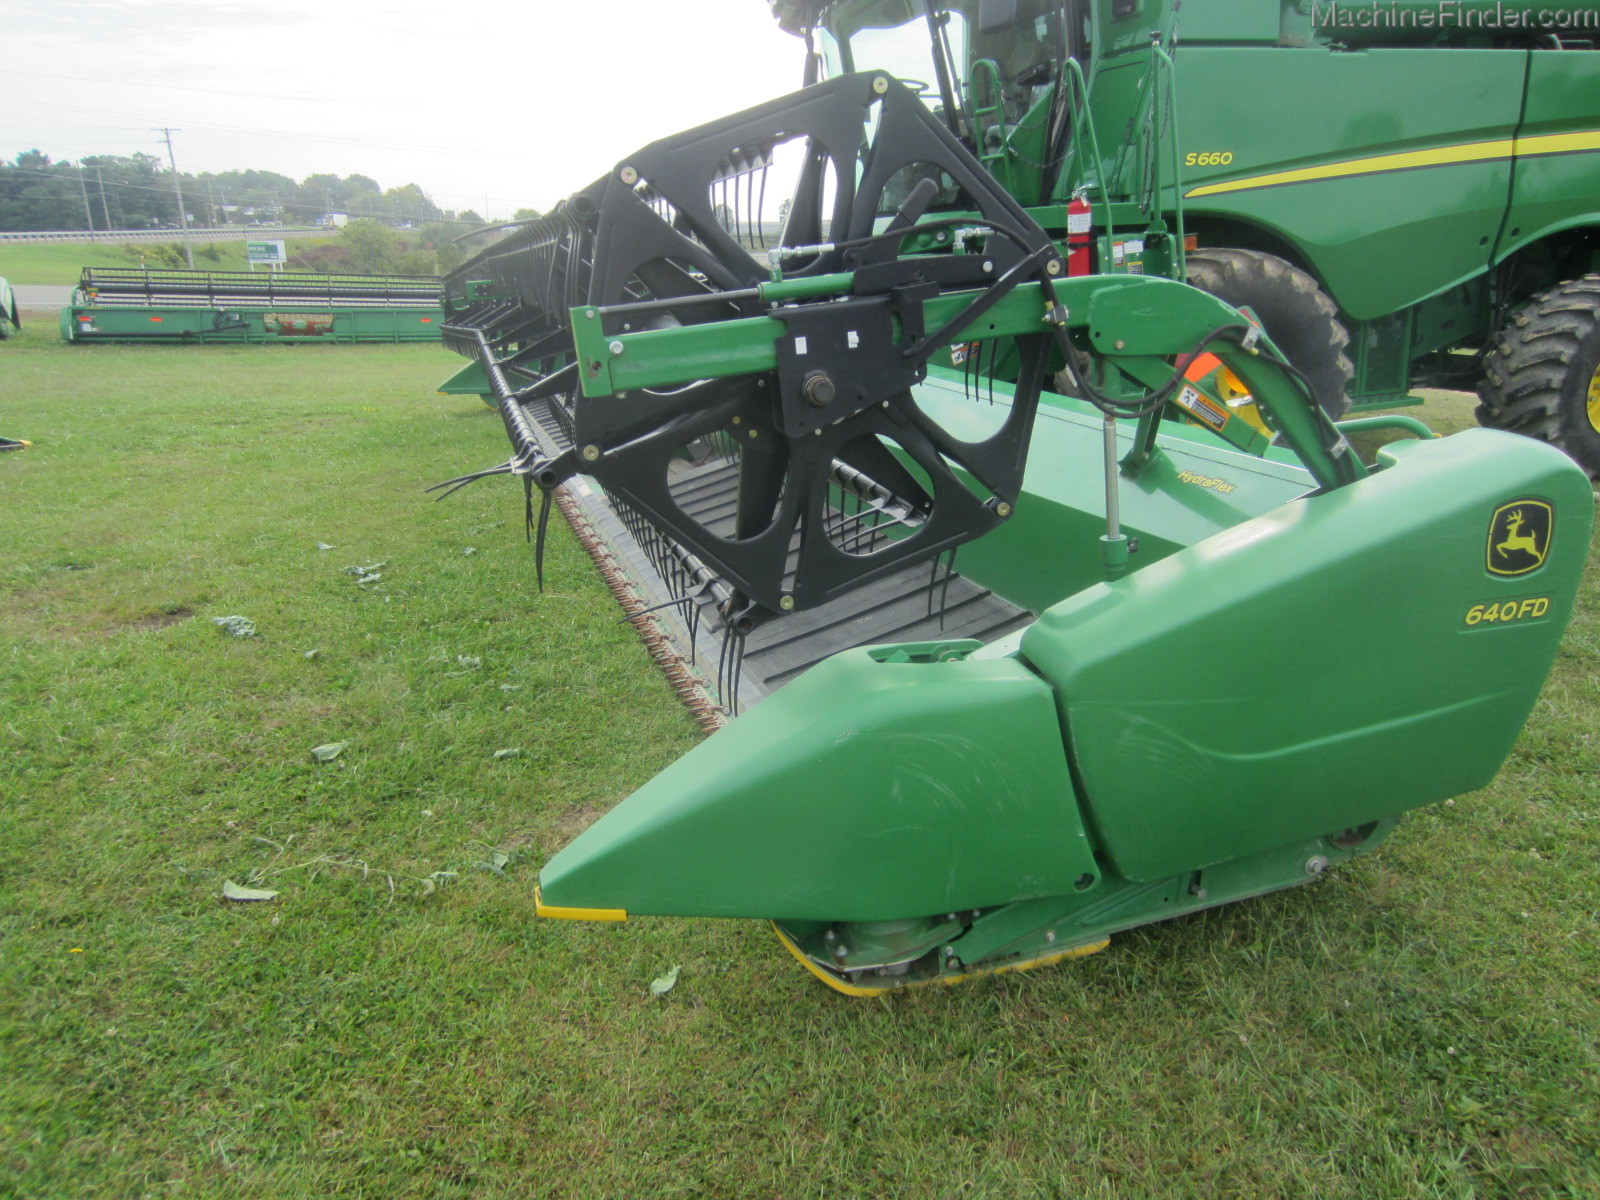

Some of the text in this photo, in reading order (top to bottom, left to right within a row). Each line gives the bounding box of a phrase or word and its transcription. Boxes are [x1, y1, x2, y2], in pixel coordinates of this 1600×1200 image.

[1185, 152, 1233, 166] S660
[1177, 469, 1237, 494] HydraFlex
[1465, 597, 1549, 626] 640FD
